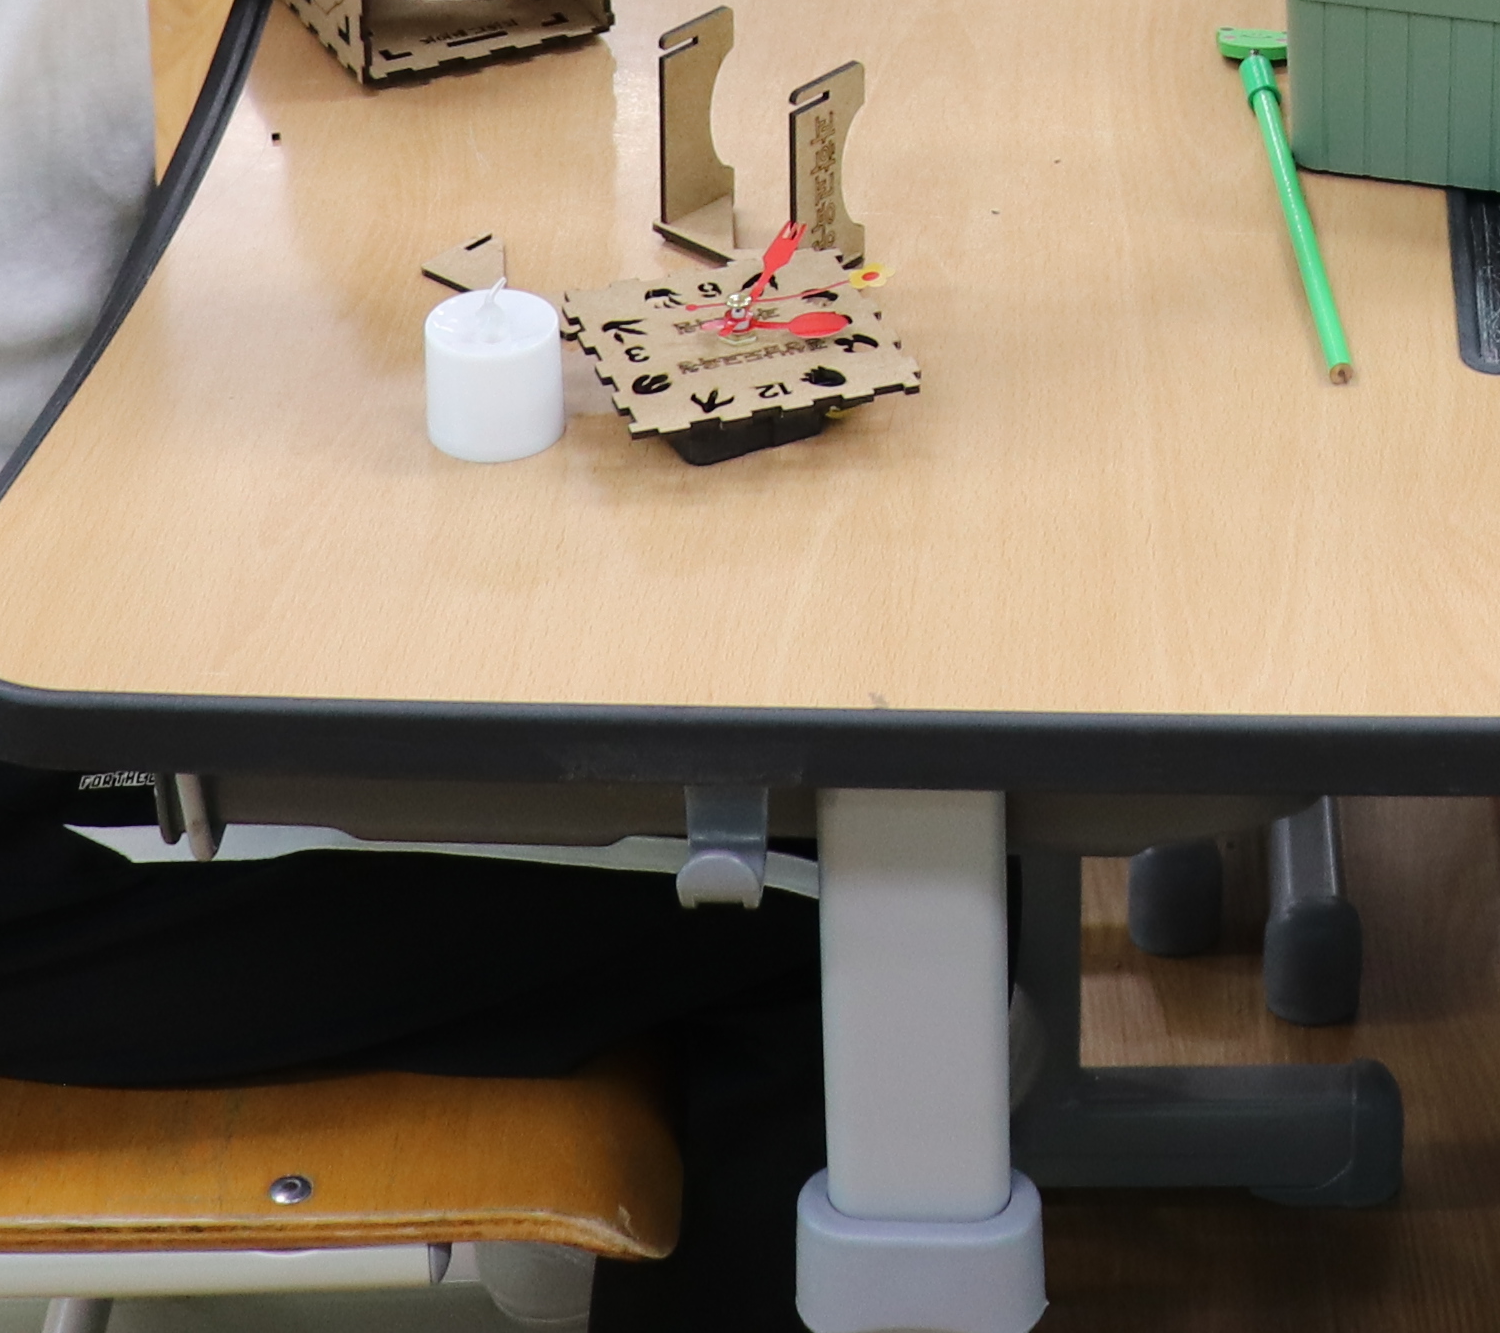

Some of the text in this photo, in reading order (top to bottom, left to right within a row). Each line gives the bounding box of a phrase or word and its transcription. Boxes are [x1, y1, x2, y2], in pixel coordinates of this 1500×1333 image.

[624, 345, 651, 364] 3
[676, 336, 828, 375] 경상남도교육청
[754, 381, 793, 400] 12
[78, 772, 114, 791] FOR
